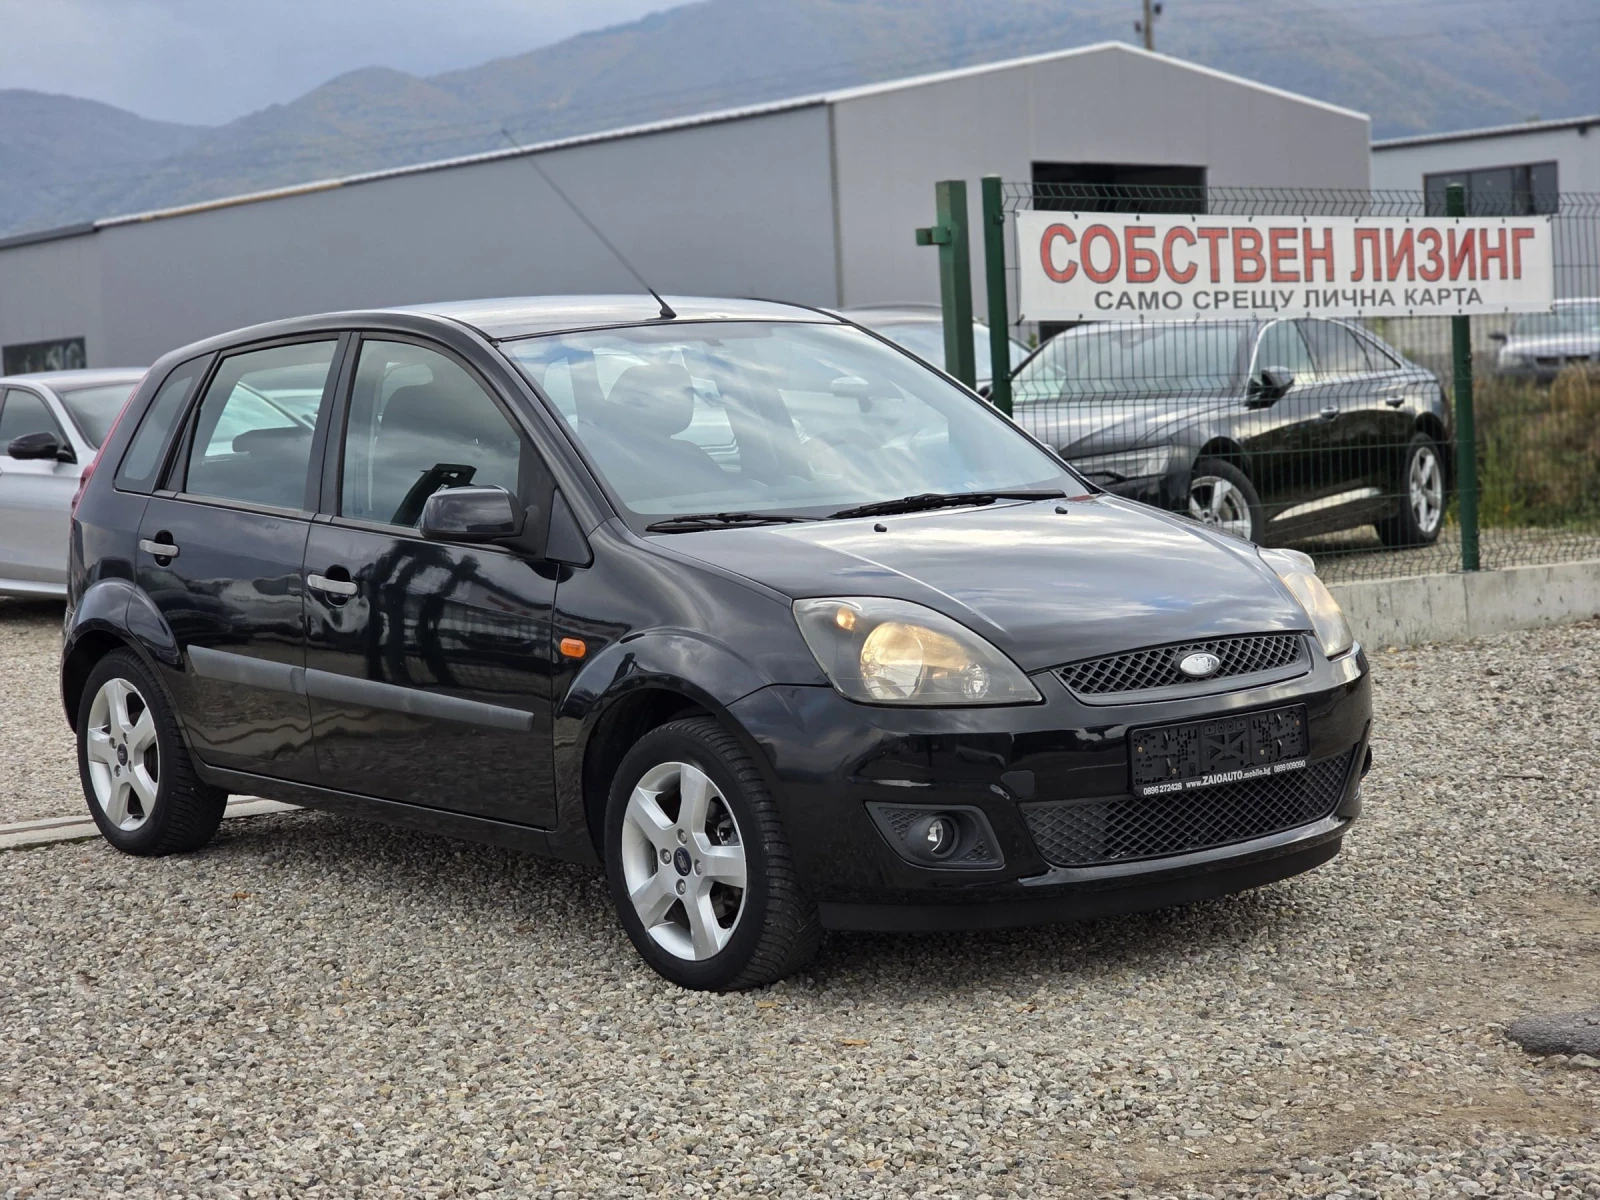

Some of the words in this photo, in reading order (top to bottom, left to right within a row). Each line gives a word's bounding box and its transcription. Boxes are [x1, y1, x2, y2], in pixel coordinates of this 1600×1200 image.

[1040, 223, 1335, 284] СОБСТВЕН
[1351, 226, 1535, 282] ЛИЗИНГ
[1095, 290, 1183, 311] САМО
[1193, 289, 1295, 311] СРЕЩУ
[1303, 288, 1396, 308] ЛИЧНА
[1404, 287, 1483, 306] КАРТА
